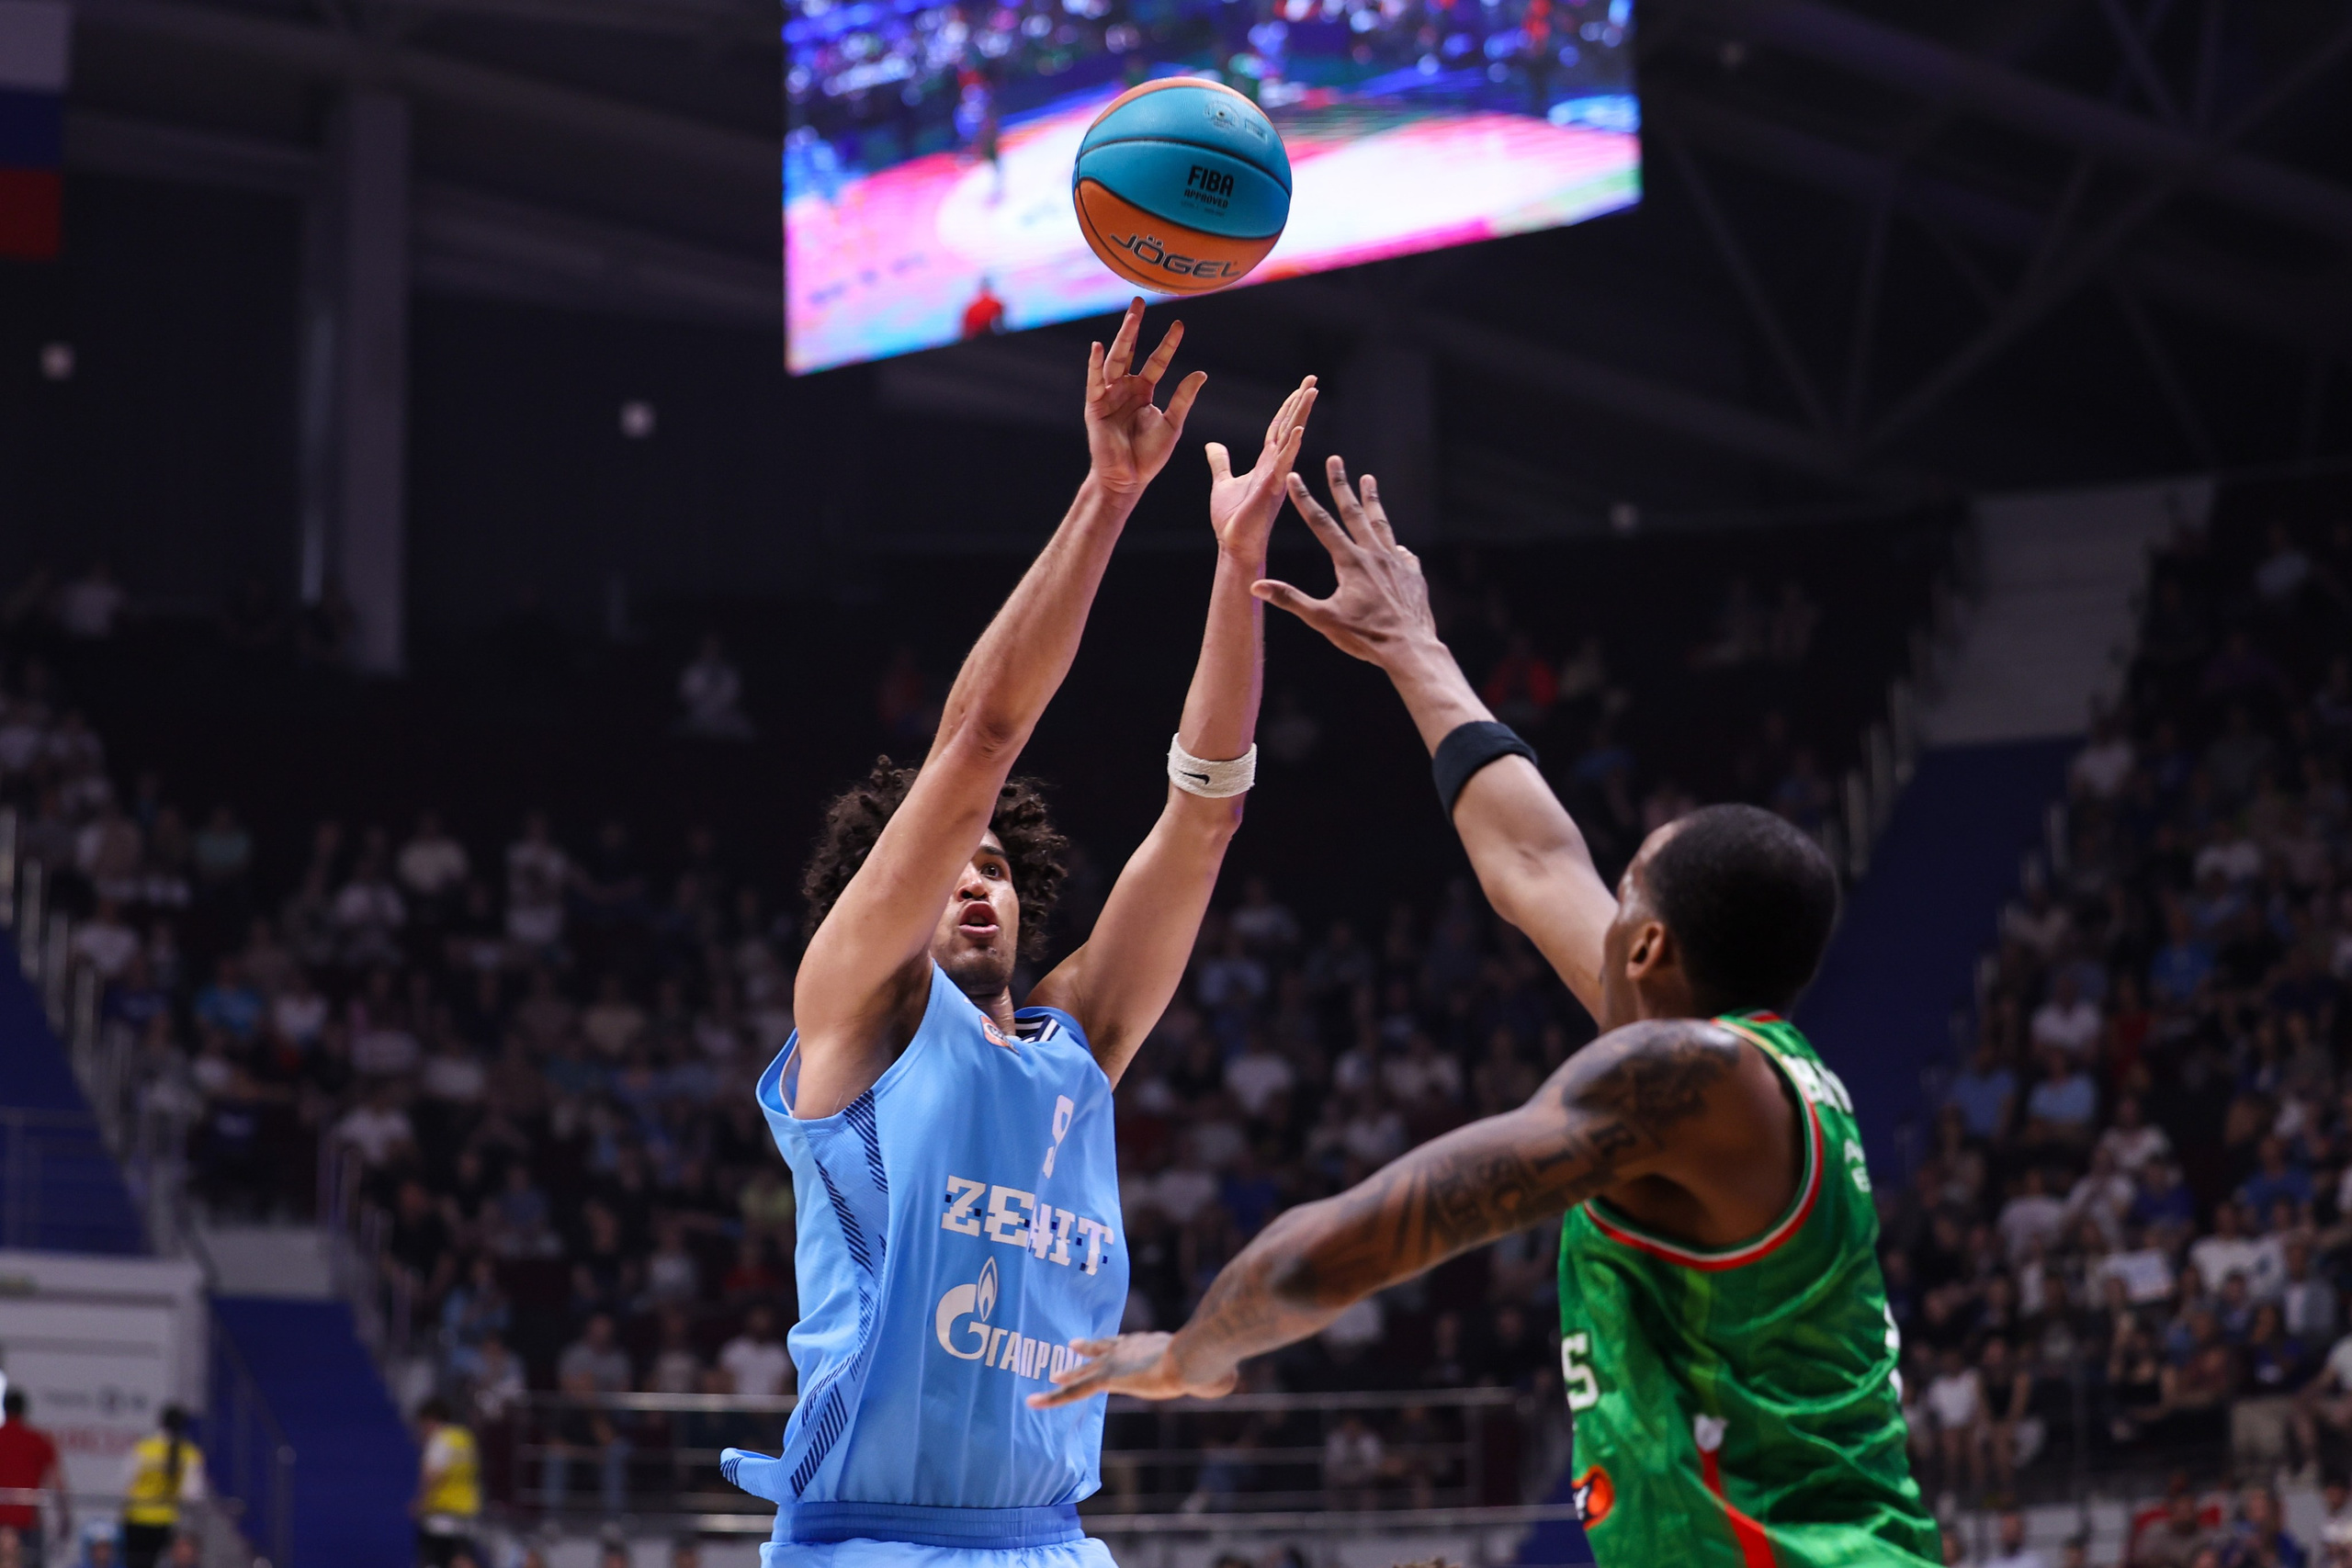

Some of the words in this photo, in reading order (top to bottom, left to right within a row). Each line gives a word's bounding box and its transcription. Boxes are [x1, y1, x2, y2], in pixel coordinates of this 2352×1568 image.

[1187, 164, 1234, 197] FIBA
[1184, 188, 1228, 209] APPROVED
[1109, 232, 1240, 279] JÖGEL
